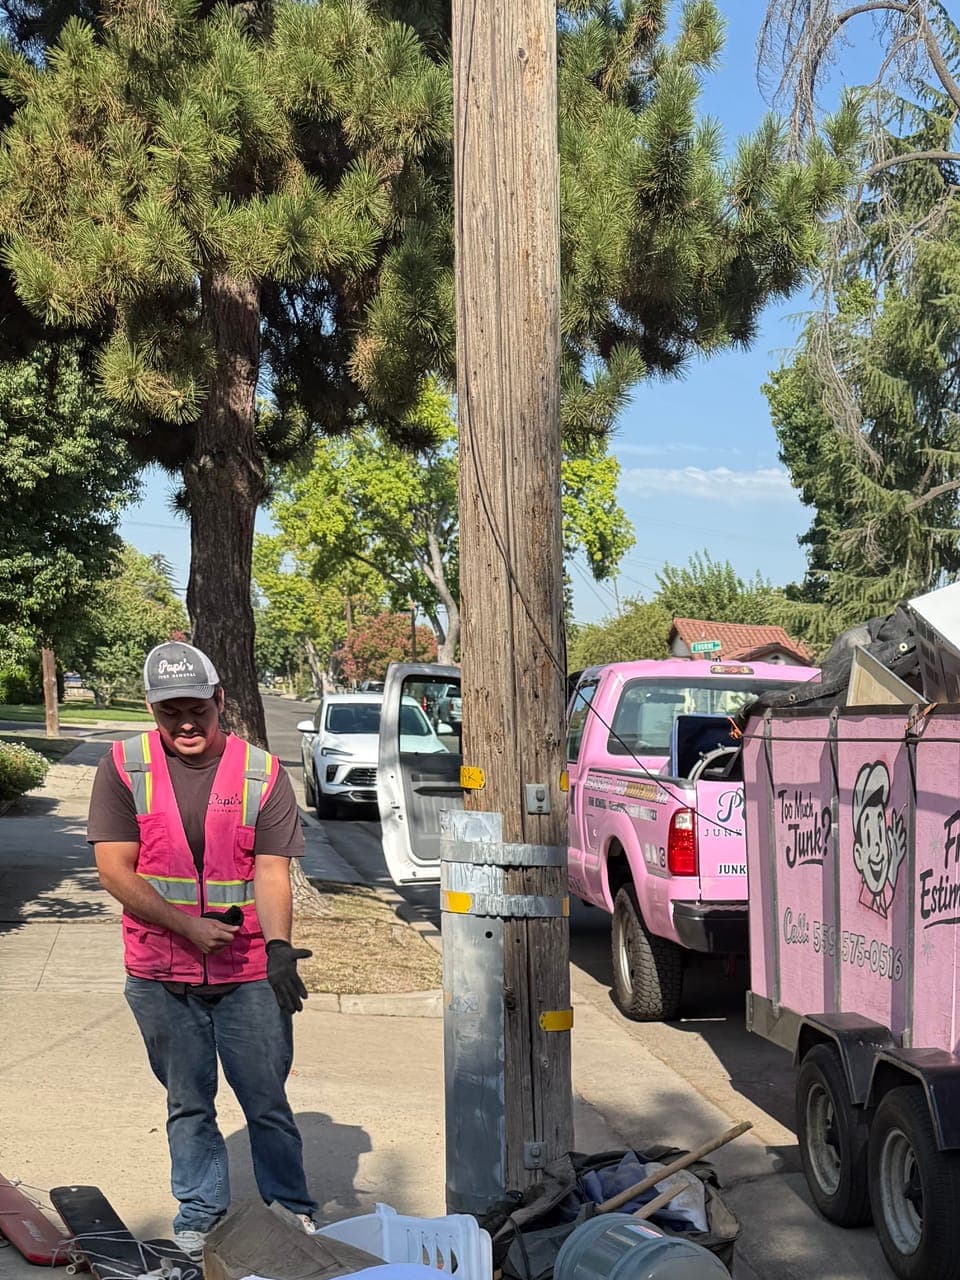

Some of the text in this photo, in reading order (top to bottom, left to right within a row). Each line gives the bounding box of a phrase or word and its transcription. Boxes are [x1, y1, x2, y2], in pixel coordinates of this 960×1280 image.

[778, 789, 814, 824] Too Much
[786, 806, 833, 869] Junk?
